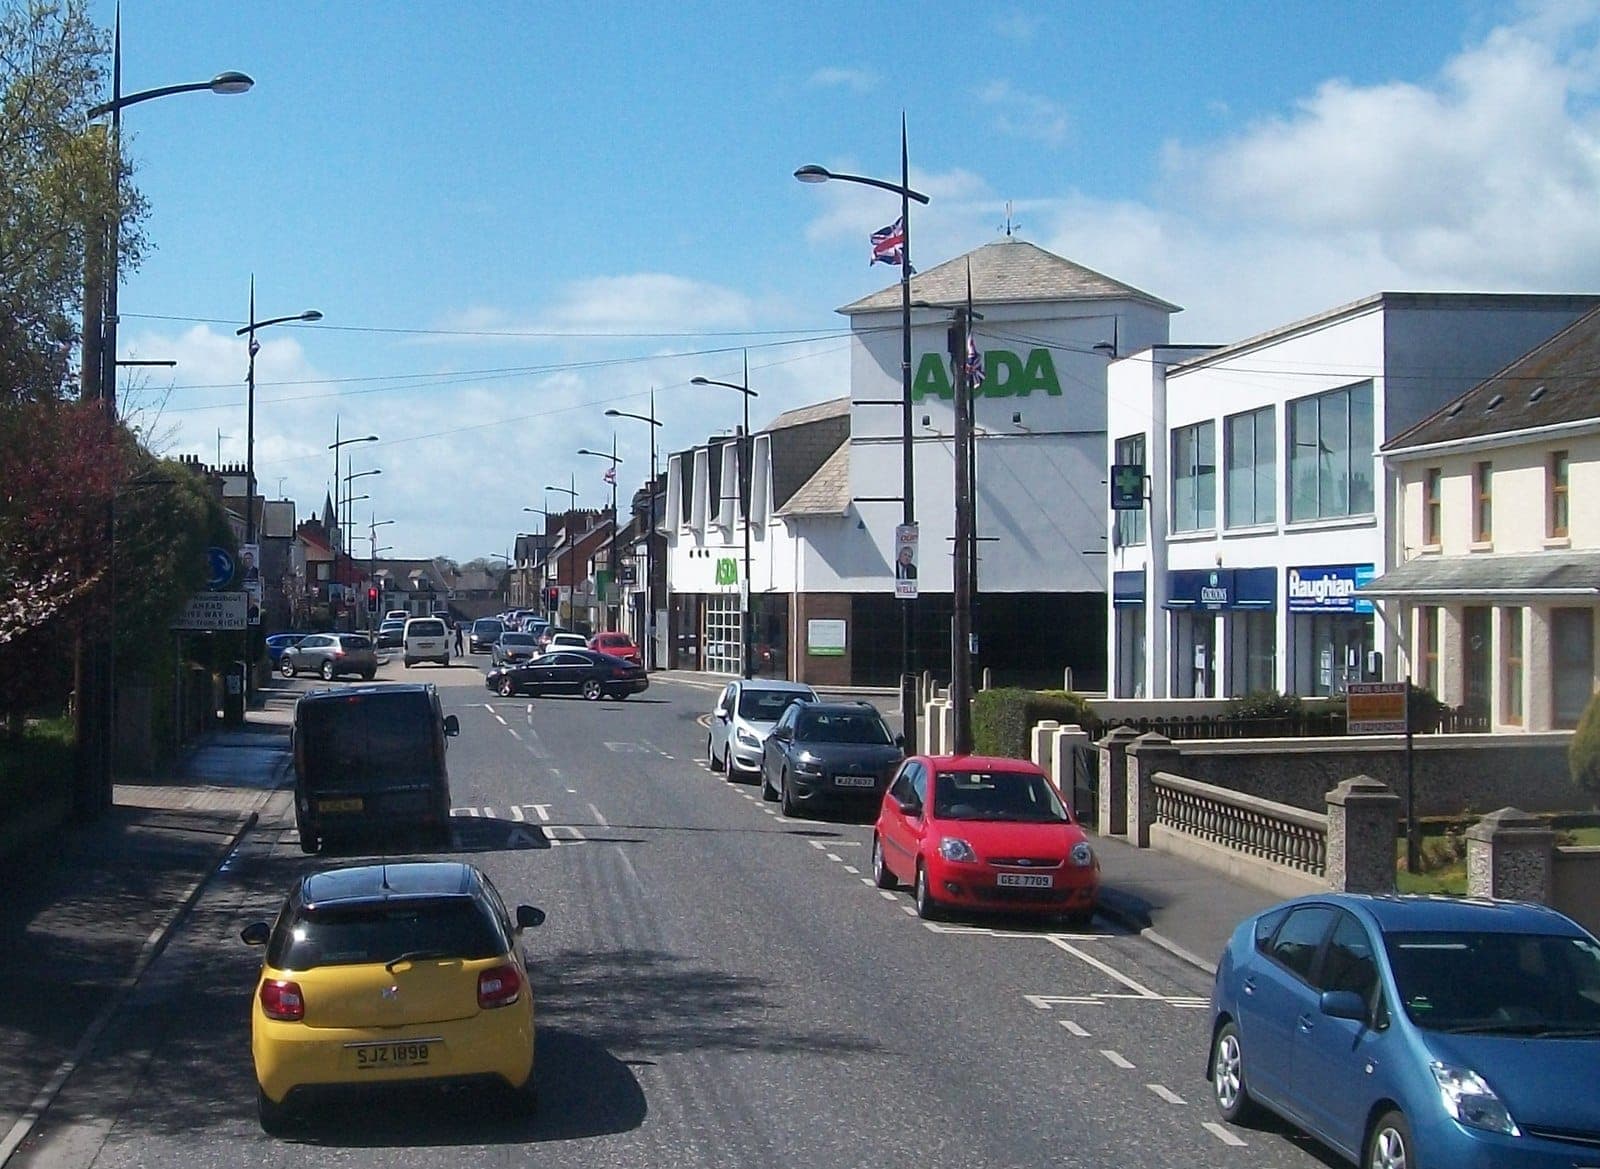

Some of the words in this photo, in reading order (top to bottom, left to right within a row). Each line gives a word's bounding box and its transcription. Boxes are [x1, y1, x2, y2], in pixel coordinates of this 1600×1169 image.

[912, 348, 1063, 401] ADA
[715, 557, 739, 586] ASDA
[1351, 685, 1371, 693] FOR
[1374, 684, 1403, 693] SALE
[1001, 875, 1020, 885] GEZ
[1024, 875, 1049, 886] 7709
[357, 1047, 388, 1063] SJZ
